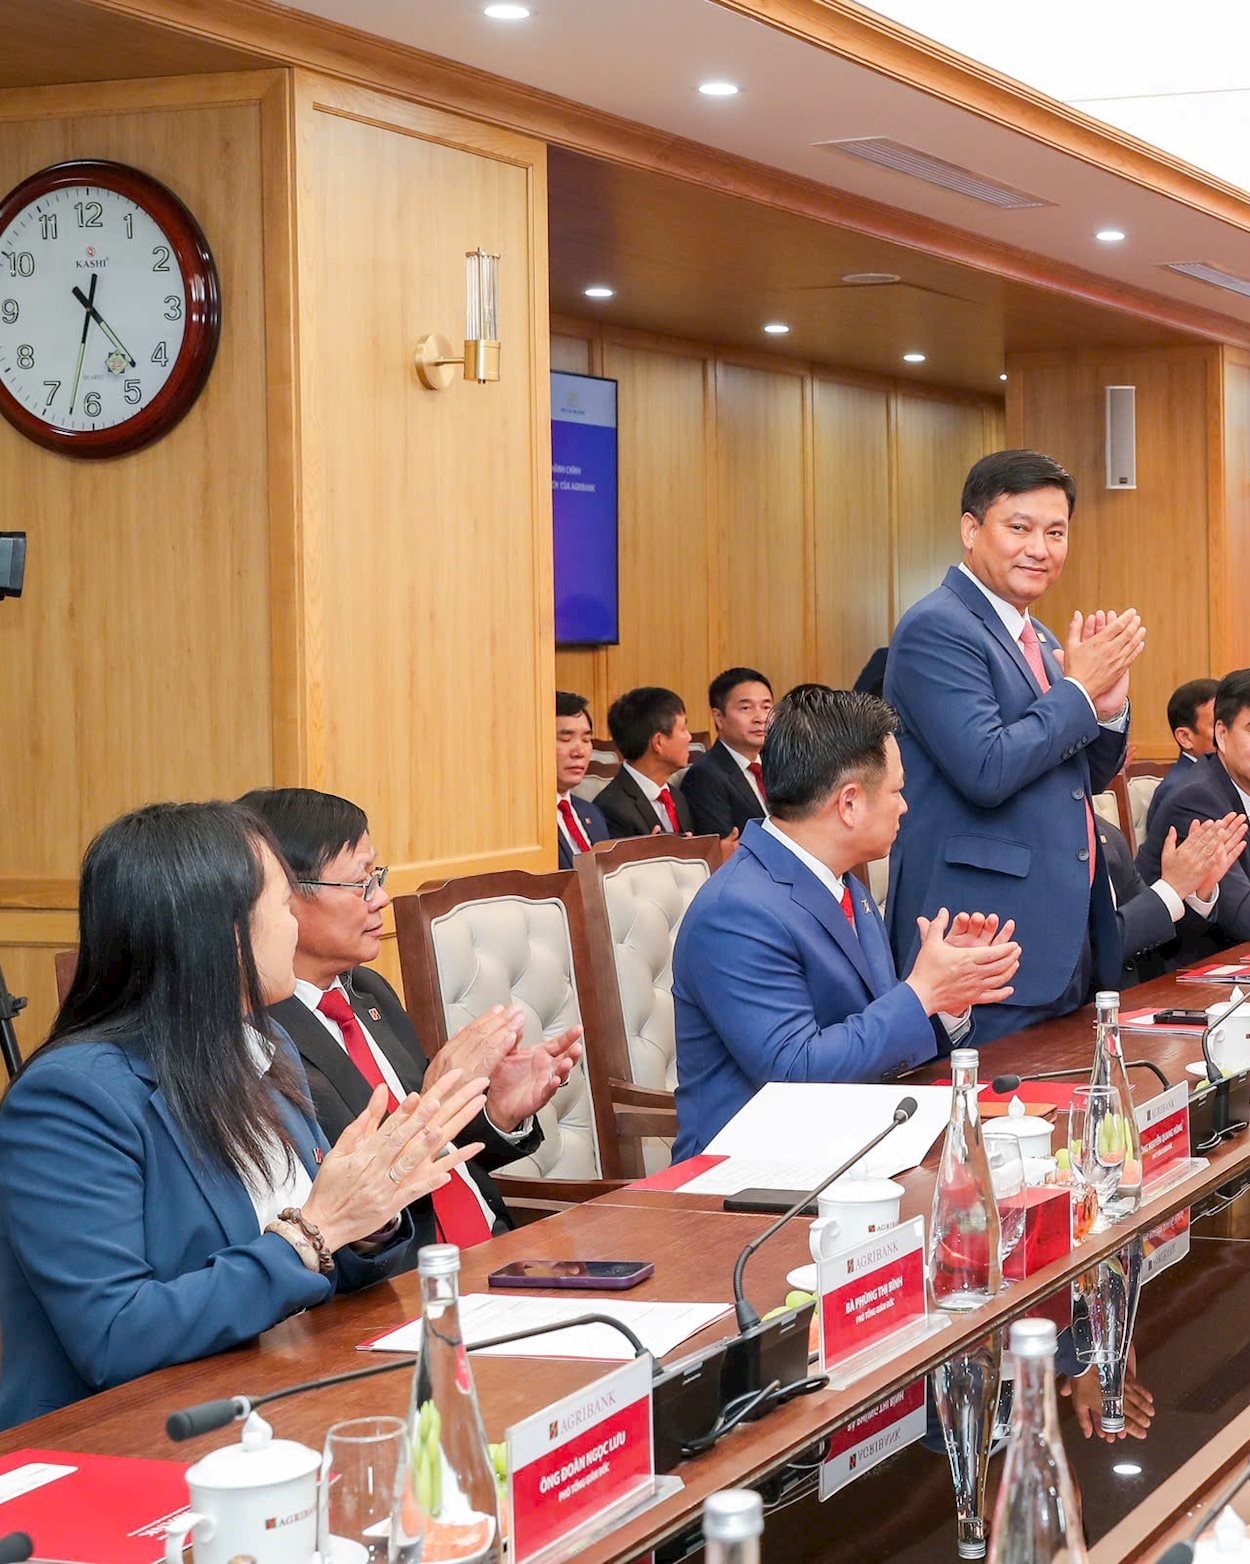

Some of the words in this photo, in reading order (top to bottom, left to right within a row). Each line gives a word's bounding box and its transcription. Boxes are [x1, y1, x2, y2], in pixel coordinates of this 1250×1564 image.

[38, 214, 58, 240] 11
[74, 202, 103, 228] 12
[123, 213, 133, 239] 1
[7, 252, 35, 278] 10
[76, 260, 107, 269] KASHI
[152, 245, 170, 272] 2
[1, 299, 20, 324] 9
[164, 295, 182, 321] 3
[16, 344, 35, 369] 8
[151, 341, 169, 367] 4
[43, 380, 61, 406] 7
[83, 392, 102, 417] 6
[124, 379, 142, 405] 5
[855, 1240, 899, 1271] AGRIBANK
[846, 1299, 855, 1314] BÀ
[855, 1288, 877, 1310] PHÙNG
[560, 1390, 617, 1435] AGRIBANK
[540, 1474, 560, 1493] ÔNG
[561, 1456, 586, 1481] ĐOÀN
[586, 1441, 608, 1466] NGỌC
[608, 1431, 626, 1452] LƯU
